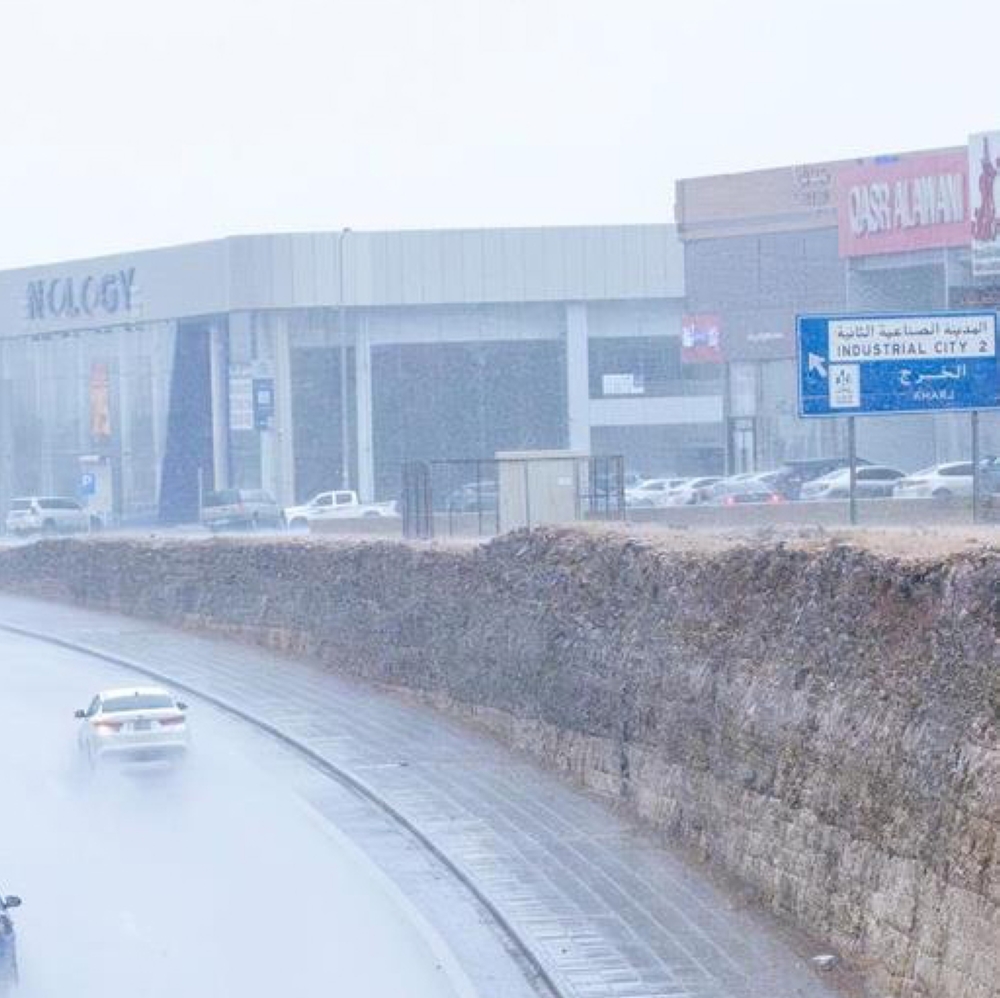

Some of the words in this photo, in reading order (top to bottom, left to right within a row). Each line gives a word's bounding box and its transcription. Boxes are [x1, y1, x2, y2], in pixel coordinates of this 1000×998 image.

[837, 324, 874, 338] الثانية
[879, 321, 940, 337] الصناعية
[837, 342, 927, 357] INDUSTRIAL
[934, 341, 967, 354] CITY
[978, 340, 988, 352] 2
[899, 363, 966, 386] الخرج
